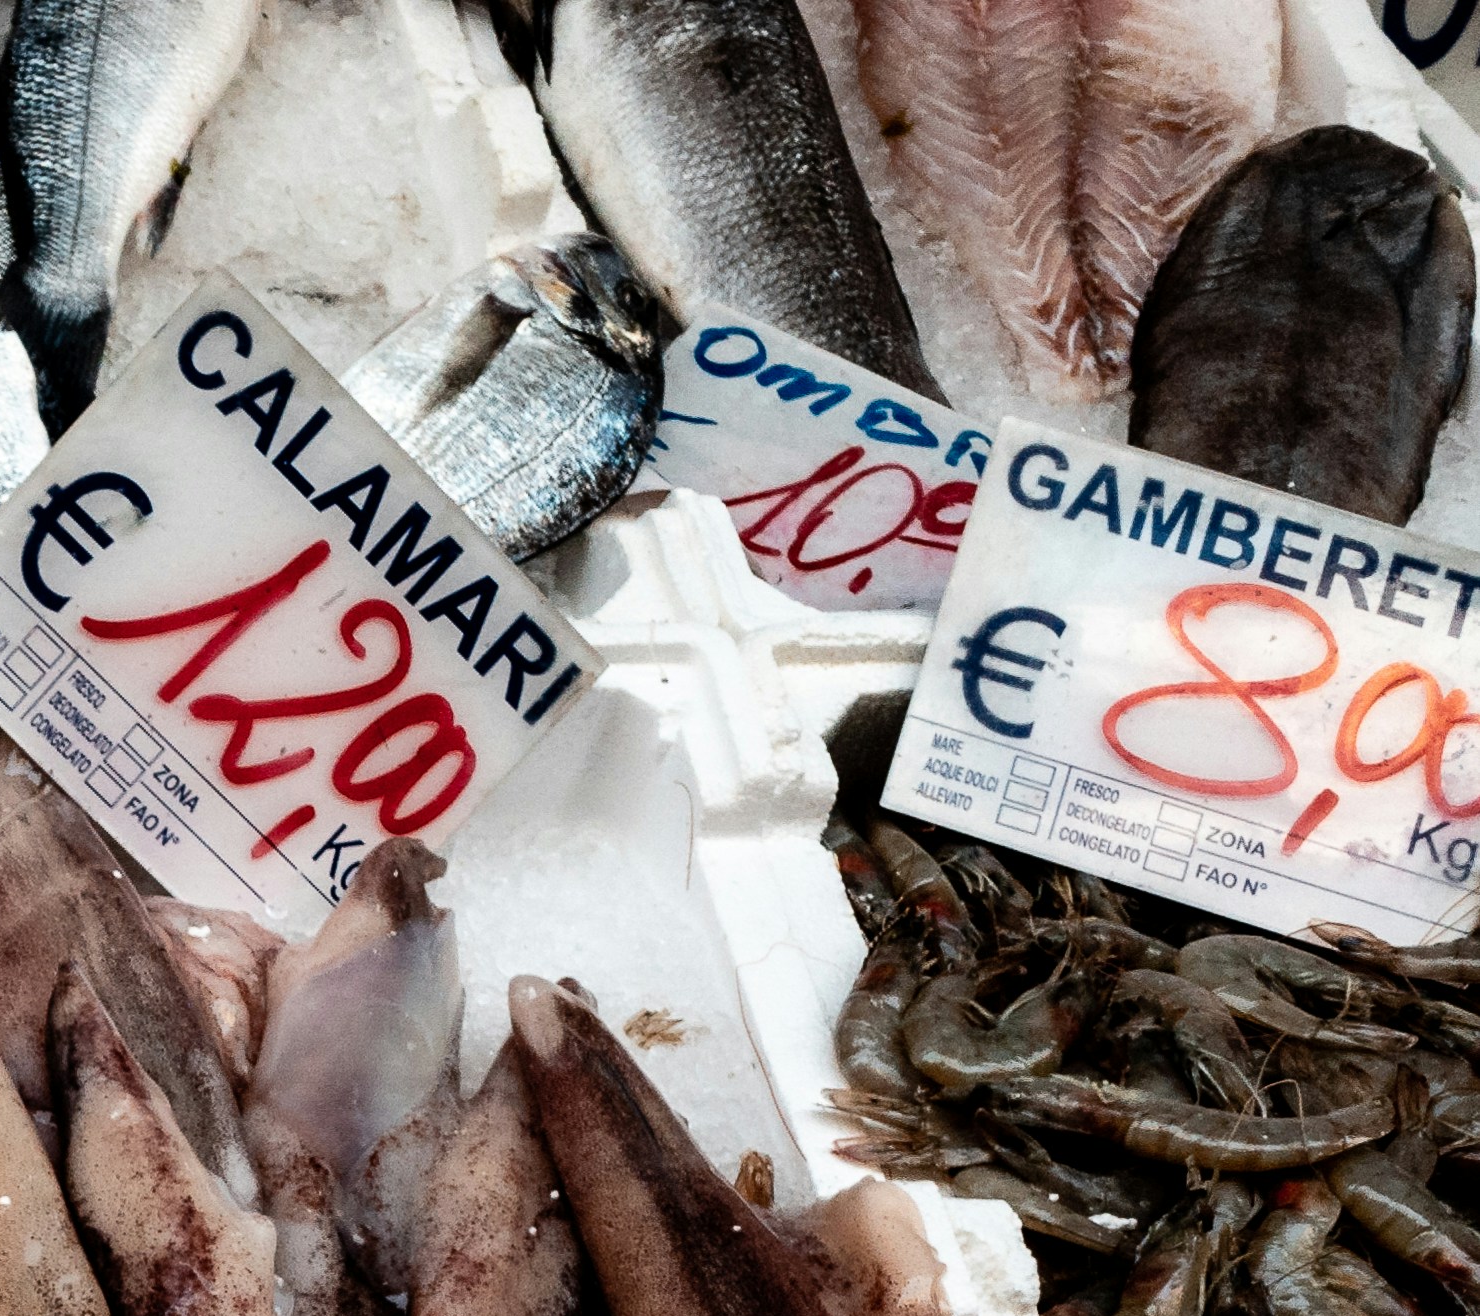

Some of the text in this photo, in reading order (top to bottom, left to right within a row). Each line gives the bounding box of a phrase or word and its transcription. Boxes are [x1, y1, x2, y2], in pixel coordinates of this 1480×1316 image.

[178, 310, 582, 726] CALAMARI
[21, 471, 153, 612] €
[67, 670, 106, 709] FRESCO
[952, 606, 1067, 739] €
[48, 691, 114, 757] DECONGELATO
[30, 712, 92, 775] CONGELATO
[931, 733, 964, 755] MARE
[153, 764, 199, 813] ZONA
[924, 757, 999, 792] ACQUE DOLCI
[1073, 778, 1120, 803] FRESCO
[124, 796, 159, 832] FAO
[916, 781, 972, 811] ALLEVATO
[1066, 802, 1151, 841] DECONGELATO
[1059, 827, 1140, 863] CONGELATO
[1206, 826, 1265, 858] ZONA
[1195, 864, 1268, 896] FAO N°
